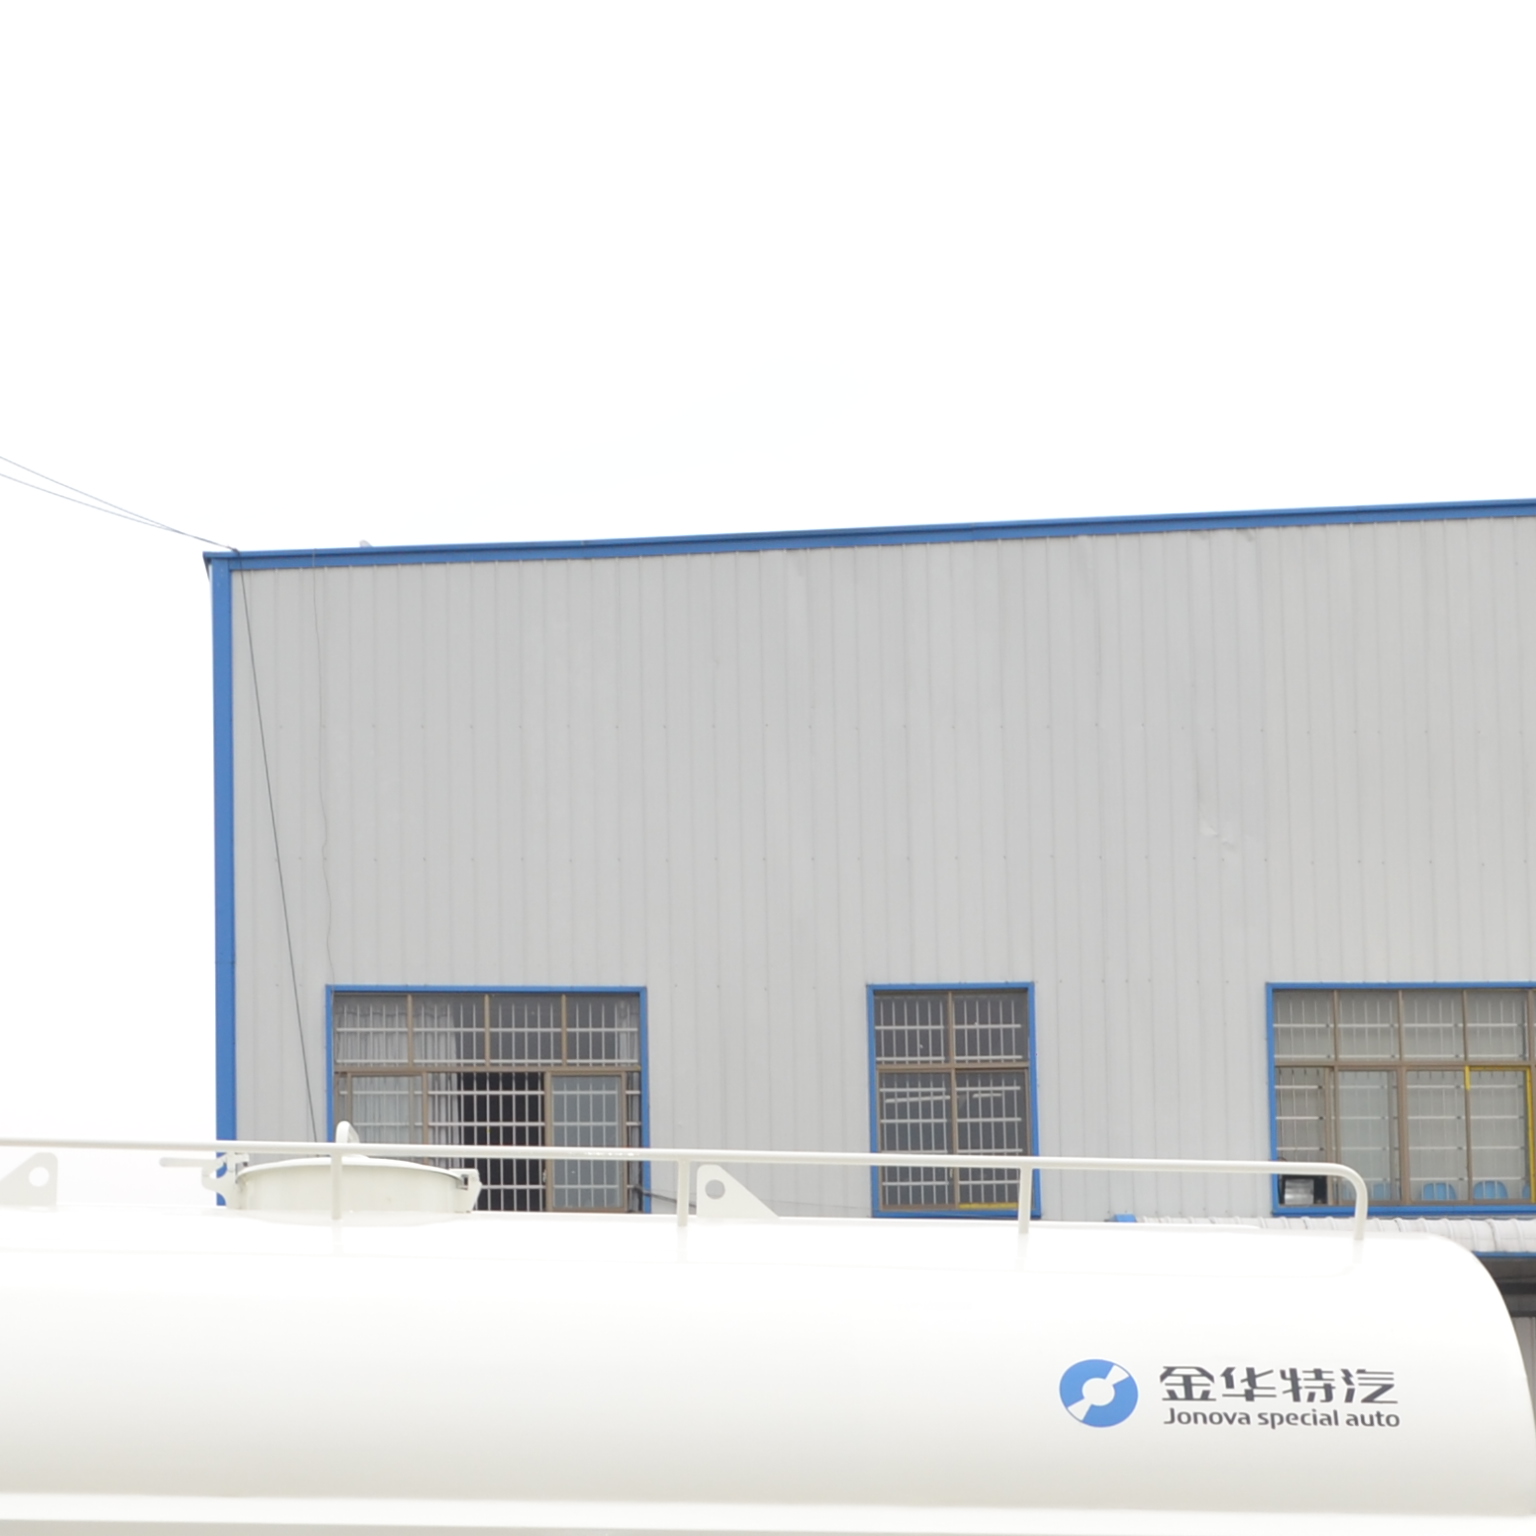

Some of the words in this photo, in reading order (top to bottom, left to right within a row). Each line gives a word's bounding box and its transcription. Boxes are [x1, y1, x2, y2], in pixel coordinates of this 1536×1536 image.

[1160, 1366, 1399, 1405] 金华特汽
[1163, 1407, 1252, 1426] Jonova
[1257, 1409, 1340, 1430] special
[1345, 1410, 1401, 1428] auto
